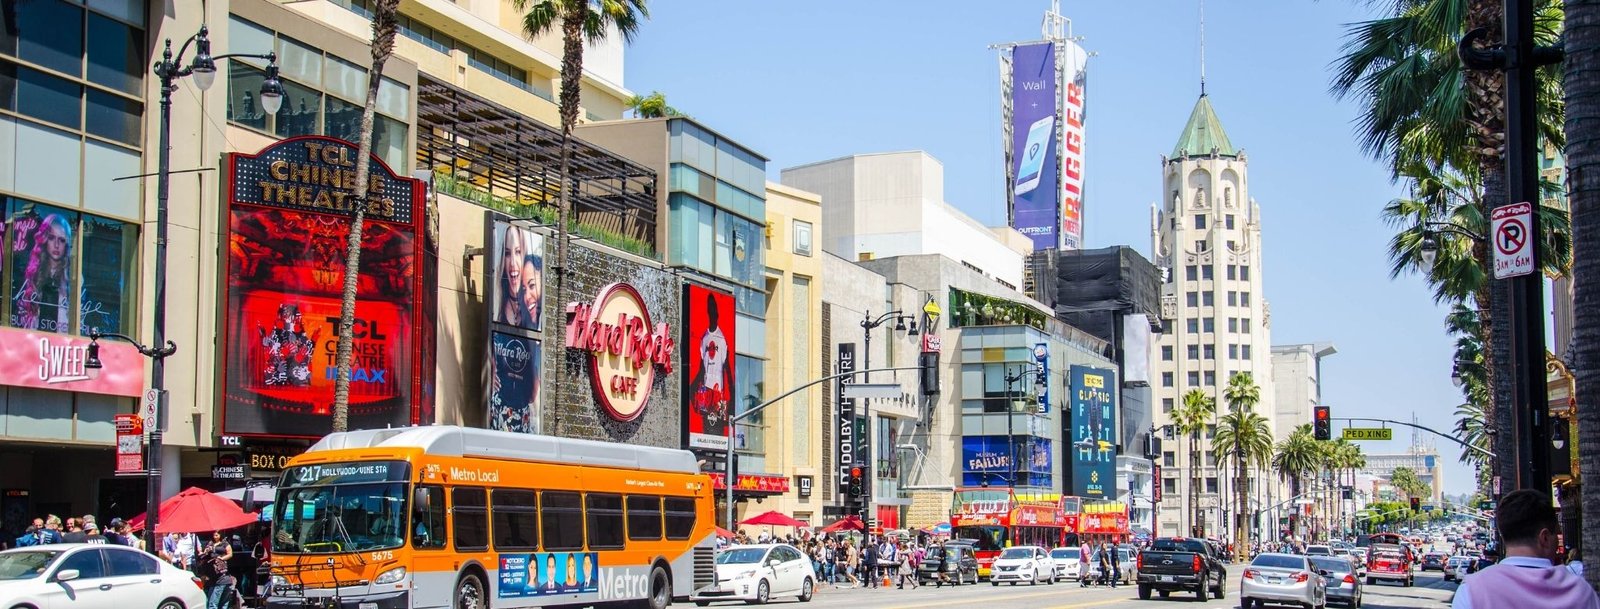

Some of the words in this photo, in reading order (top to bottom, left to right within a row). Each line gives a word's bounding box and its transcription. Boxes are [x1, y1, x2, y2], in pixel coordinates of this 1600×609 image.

[1022, 80, 1046, 90] Wall
[305, 142, 354, 167] TCL
[270, 160, 385, 194] CHINEE
[258, 182, 394, 218] THEATES
[1496, 258, 1508, 271] 3AM
[1515, 256, 1530, 268] 6AM
[326, 317, 386, 340] TCL
[566, 302, 627, 356] Hard
[624, 315, 674, 374] Rock
[325, 340, 384, 358] CNESE
[39, 338, 88, 380] SWEET
[325, 353, 384, 369] TATRE
[610, 374, 638, 395] CAFE
[1086, 377, 1102, 385] TCM
[1080, 390, 1110, 402] CLASIC
[1080, 404, 1110, 419] FM
[222, 436, 240, 445] TCL
[841, 418, 852, 464] DOLBY
[252, 454, 274, 468] BOX
[970, 456, 1014, 470] FAILUR
[300, 466, 321, 481] 217
[322, 466, 374, 477] HOLLYWOOD/VINE
[427, 464, 440, 472] 5675
[450, 466, 476, 481] Metro
[478, 468, 499, 482] Local
[372, 552, 393, 560] 5675
[599, 568, 648, 600] Metro
